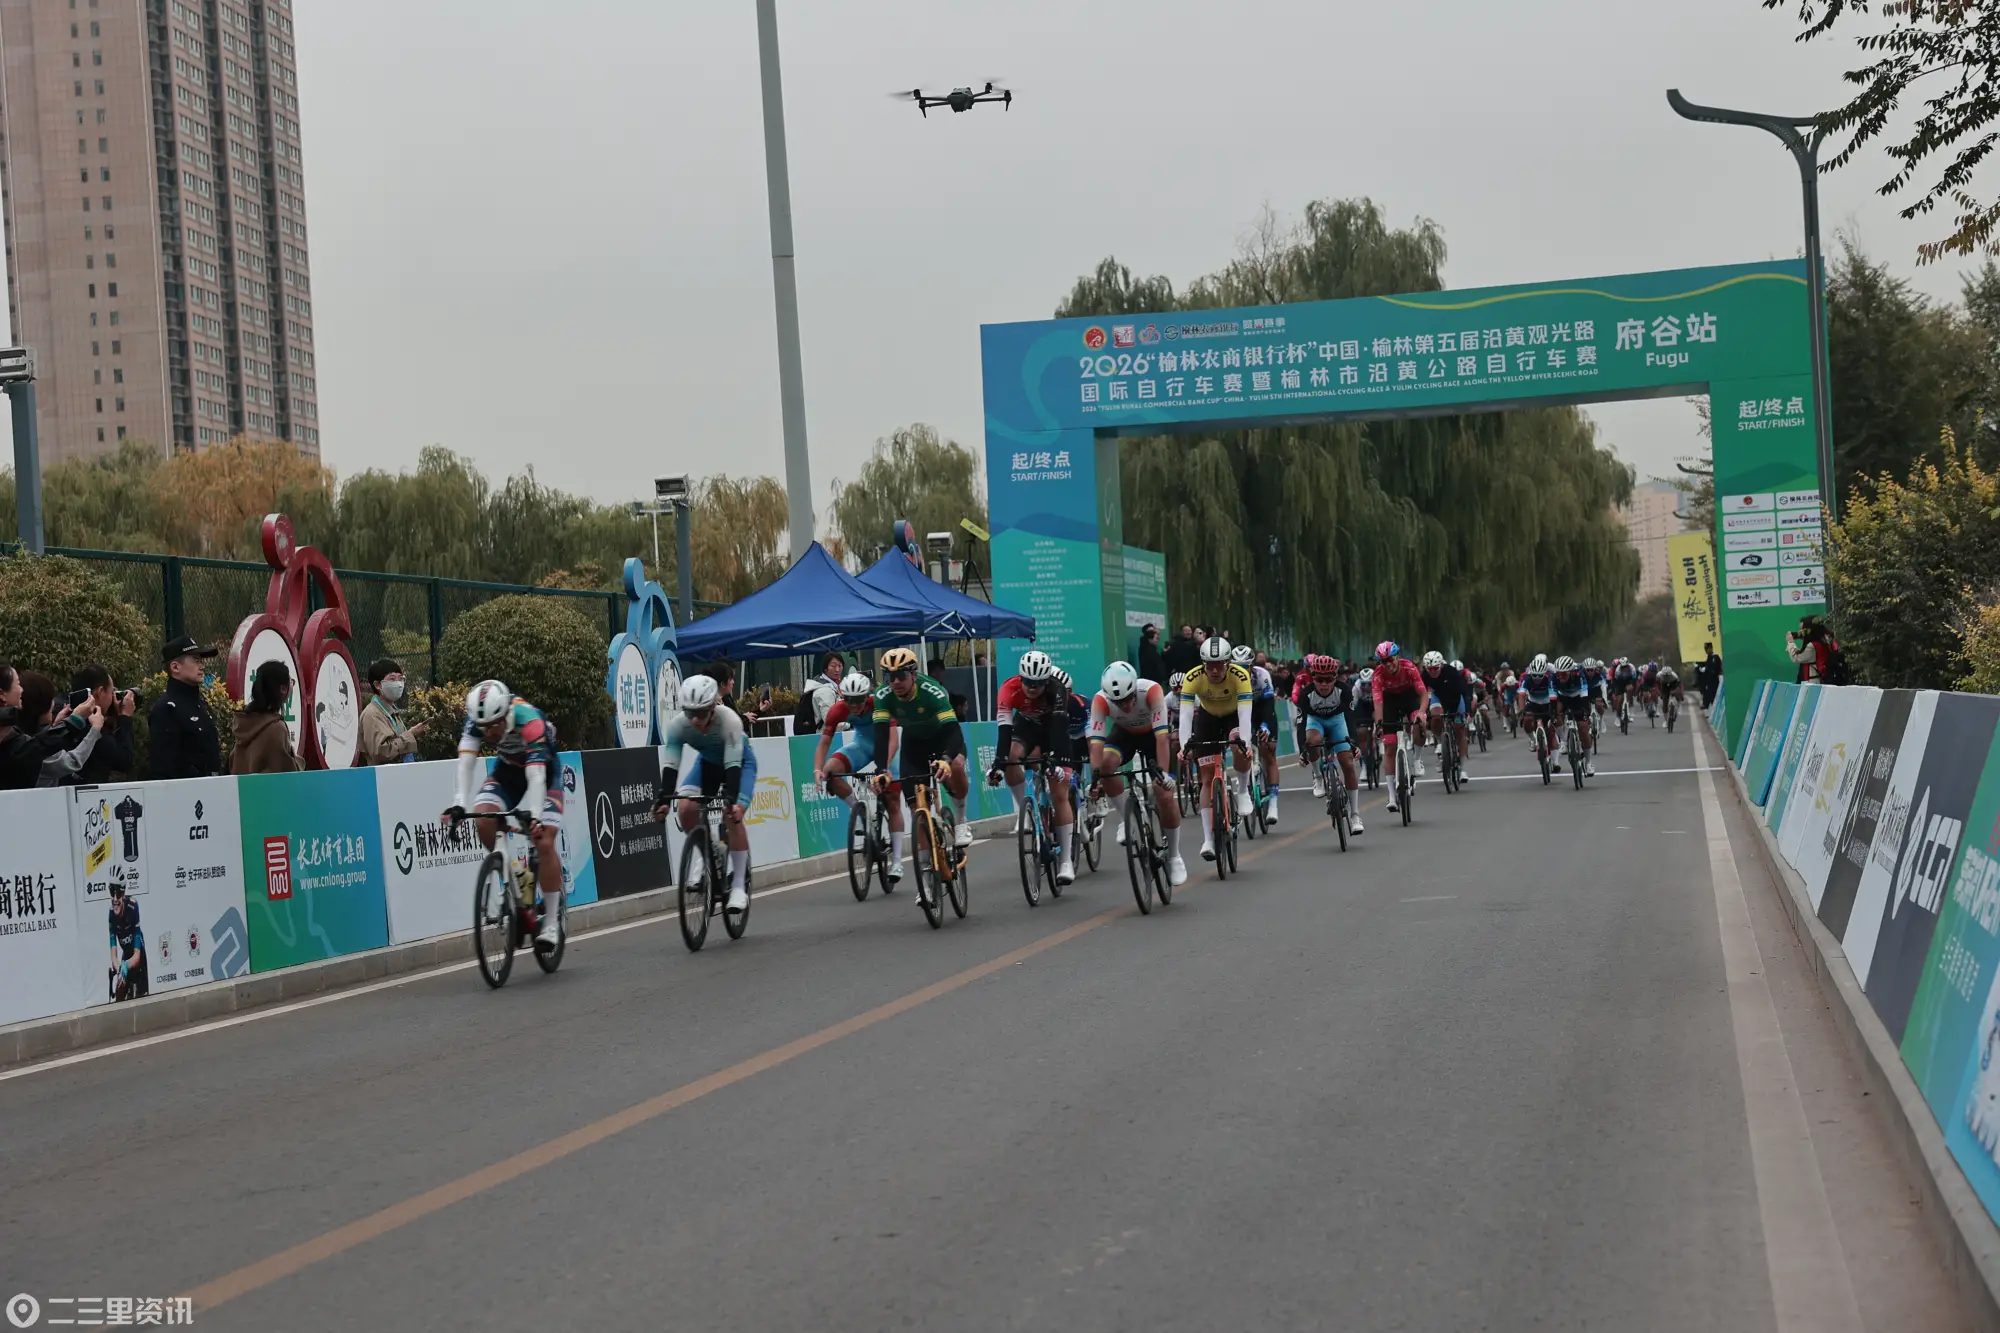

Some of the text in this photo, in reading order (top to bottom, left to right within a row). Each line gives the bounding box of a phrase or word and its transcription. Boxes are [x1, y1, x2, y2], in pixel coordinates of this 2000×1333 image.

[1615, 311, 1718, 351] 府谷站
[1646, 351, 1690, 369] Fugu
[1283, 389, 1337, 399] INTERNATIONAL
[1337, 387, 1366, 395] CYCLING
[1367, 385, 1384, 393] RACE
[1413, 382, 1442, 390] CYCLING
[1443, 380, 1461, 388] RACE
[1463, 377, 1488, 386] ALONG
[1489, 376, 1501, 384] THE
[1503, 374, 1531, 382] YELLOW
[1532, 372, 1551, 380] RIVER
[1553, 370, 1577, 378] SCENIC
[1578, 368, 1599, 376] ROAD
[1739, 396, 1805, 420] 起/终点
[1737, 417, 1805, 431] START/FINISH
[1011, 450, 1071, 471] 起/终点
[1011, 468, 1072, 482] START/FINISH
[620, 673, 646, 715] 诚信
[920, 682, 946, 699] CCN
[189, 825, 209, 840] CCN
[300, 870, 367, 890] www.cnlong.group
[38, 918, 57, 931] BANK
